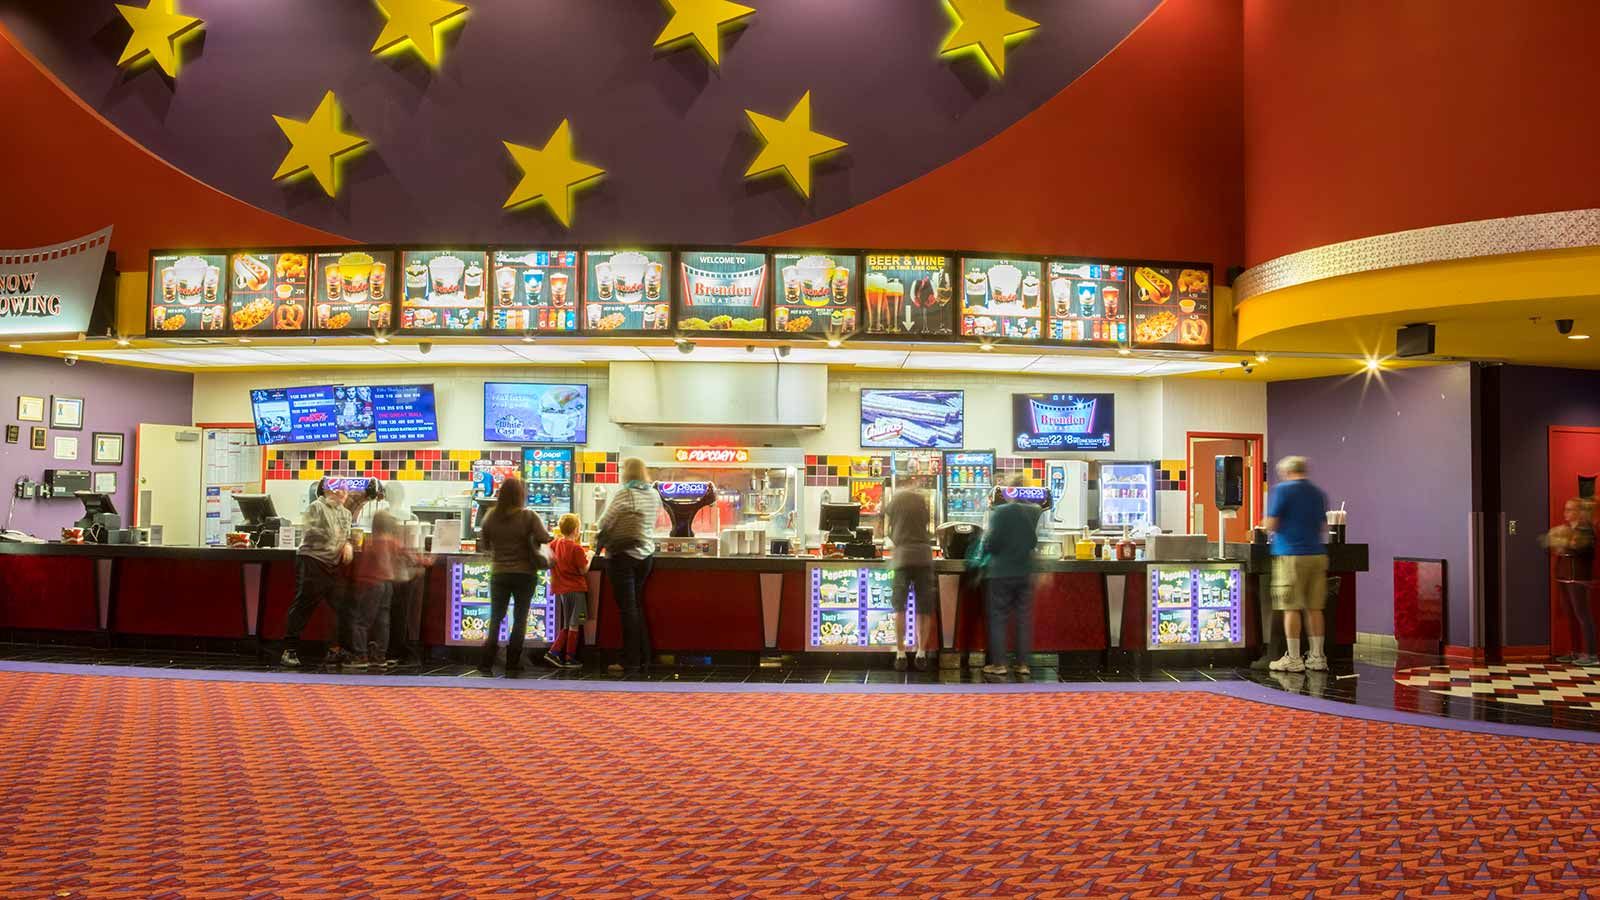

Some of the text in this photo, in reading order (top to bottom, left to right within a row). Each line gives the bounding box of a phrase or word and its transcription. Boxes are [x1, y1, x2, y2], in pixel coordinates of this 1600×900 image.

[699, 256, 735, 264] WELCOME
[869, 256, 945, 266] BEER & WINE
[695, 283, 752, 297] Brenden
[1041, 415, 1086, 426] Brenden
[688, 449, 737, 462] POPCORN
[675, 483, 705, 491] pepsi
[1019, 488, 1044, 497] pepsi
[464, 564, 490, 575] Popco
[822, 569, 858, 581] Popcorn
